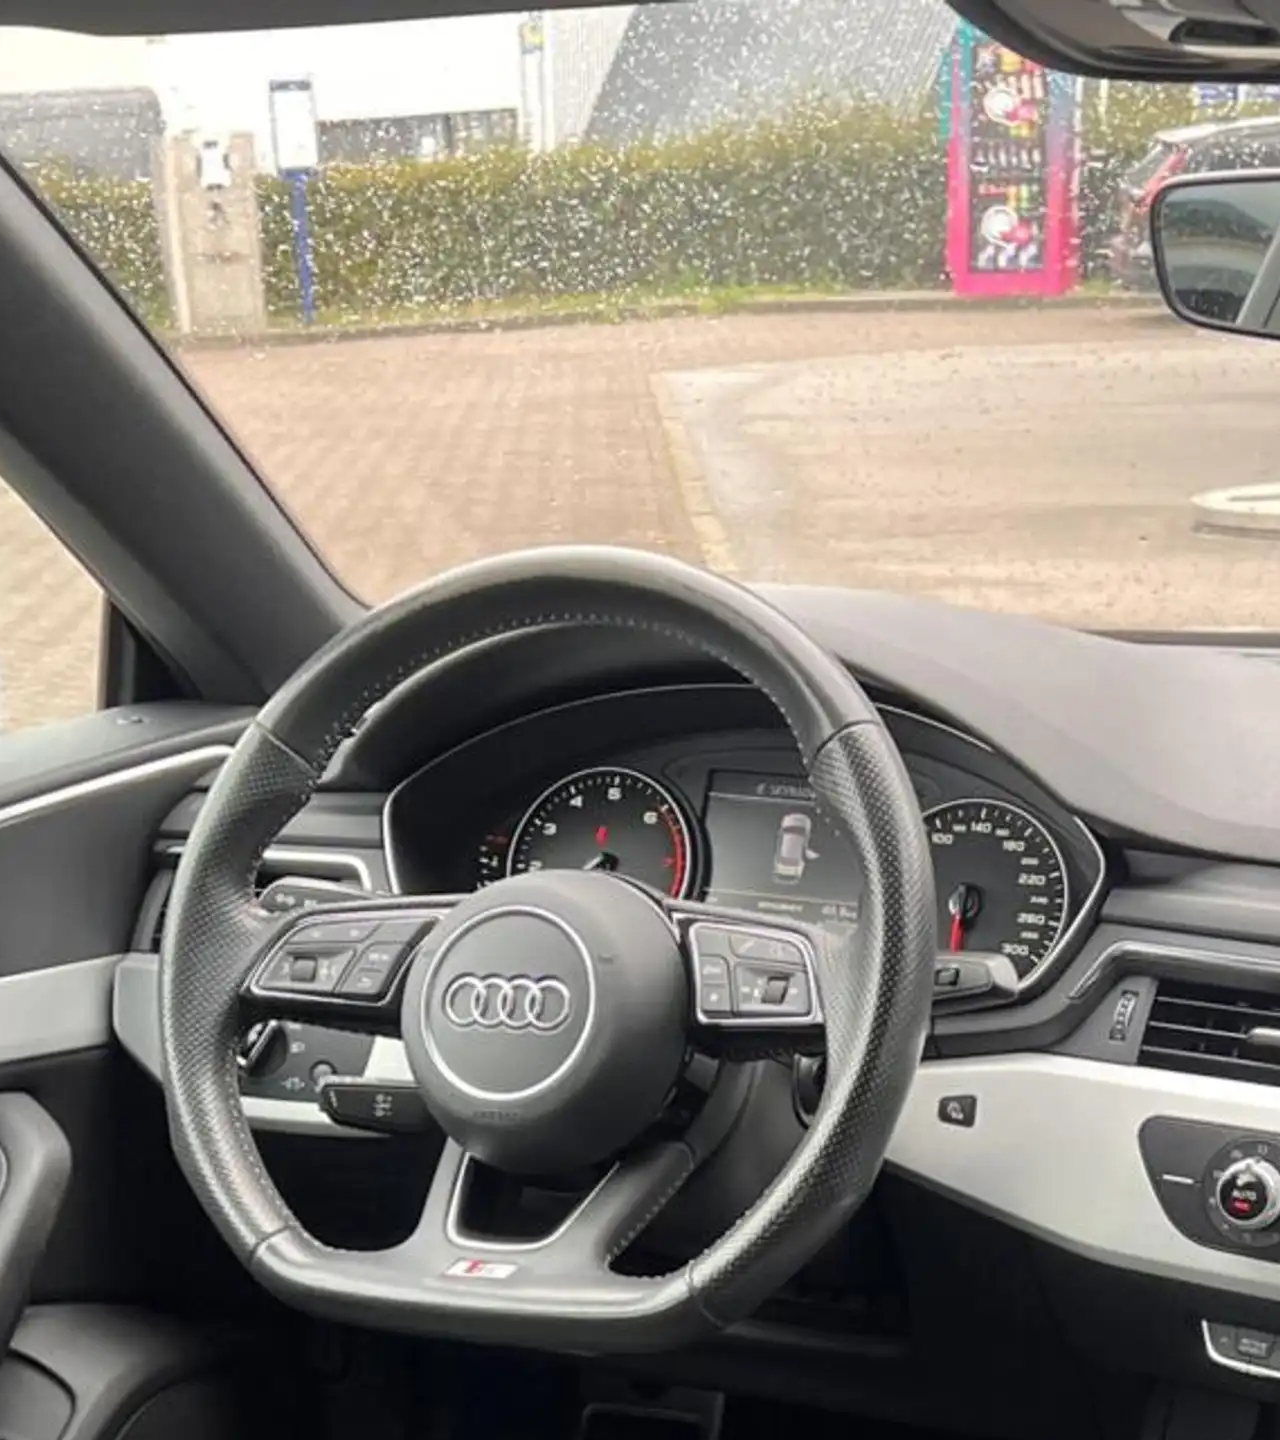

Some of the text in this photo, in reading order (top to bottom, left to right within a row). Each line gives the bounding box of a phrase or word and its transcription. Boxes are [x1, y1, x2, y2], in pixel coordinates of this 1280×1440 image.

[607, 786, 622, 800] 5
[570, 796, 583, 808] 4
[643, 811, 658, 824] 6
[543, 823, 558, 836] 3
[970, 821, 992, 834] 140
